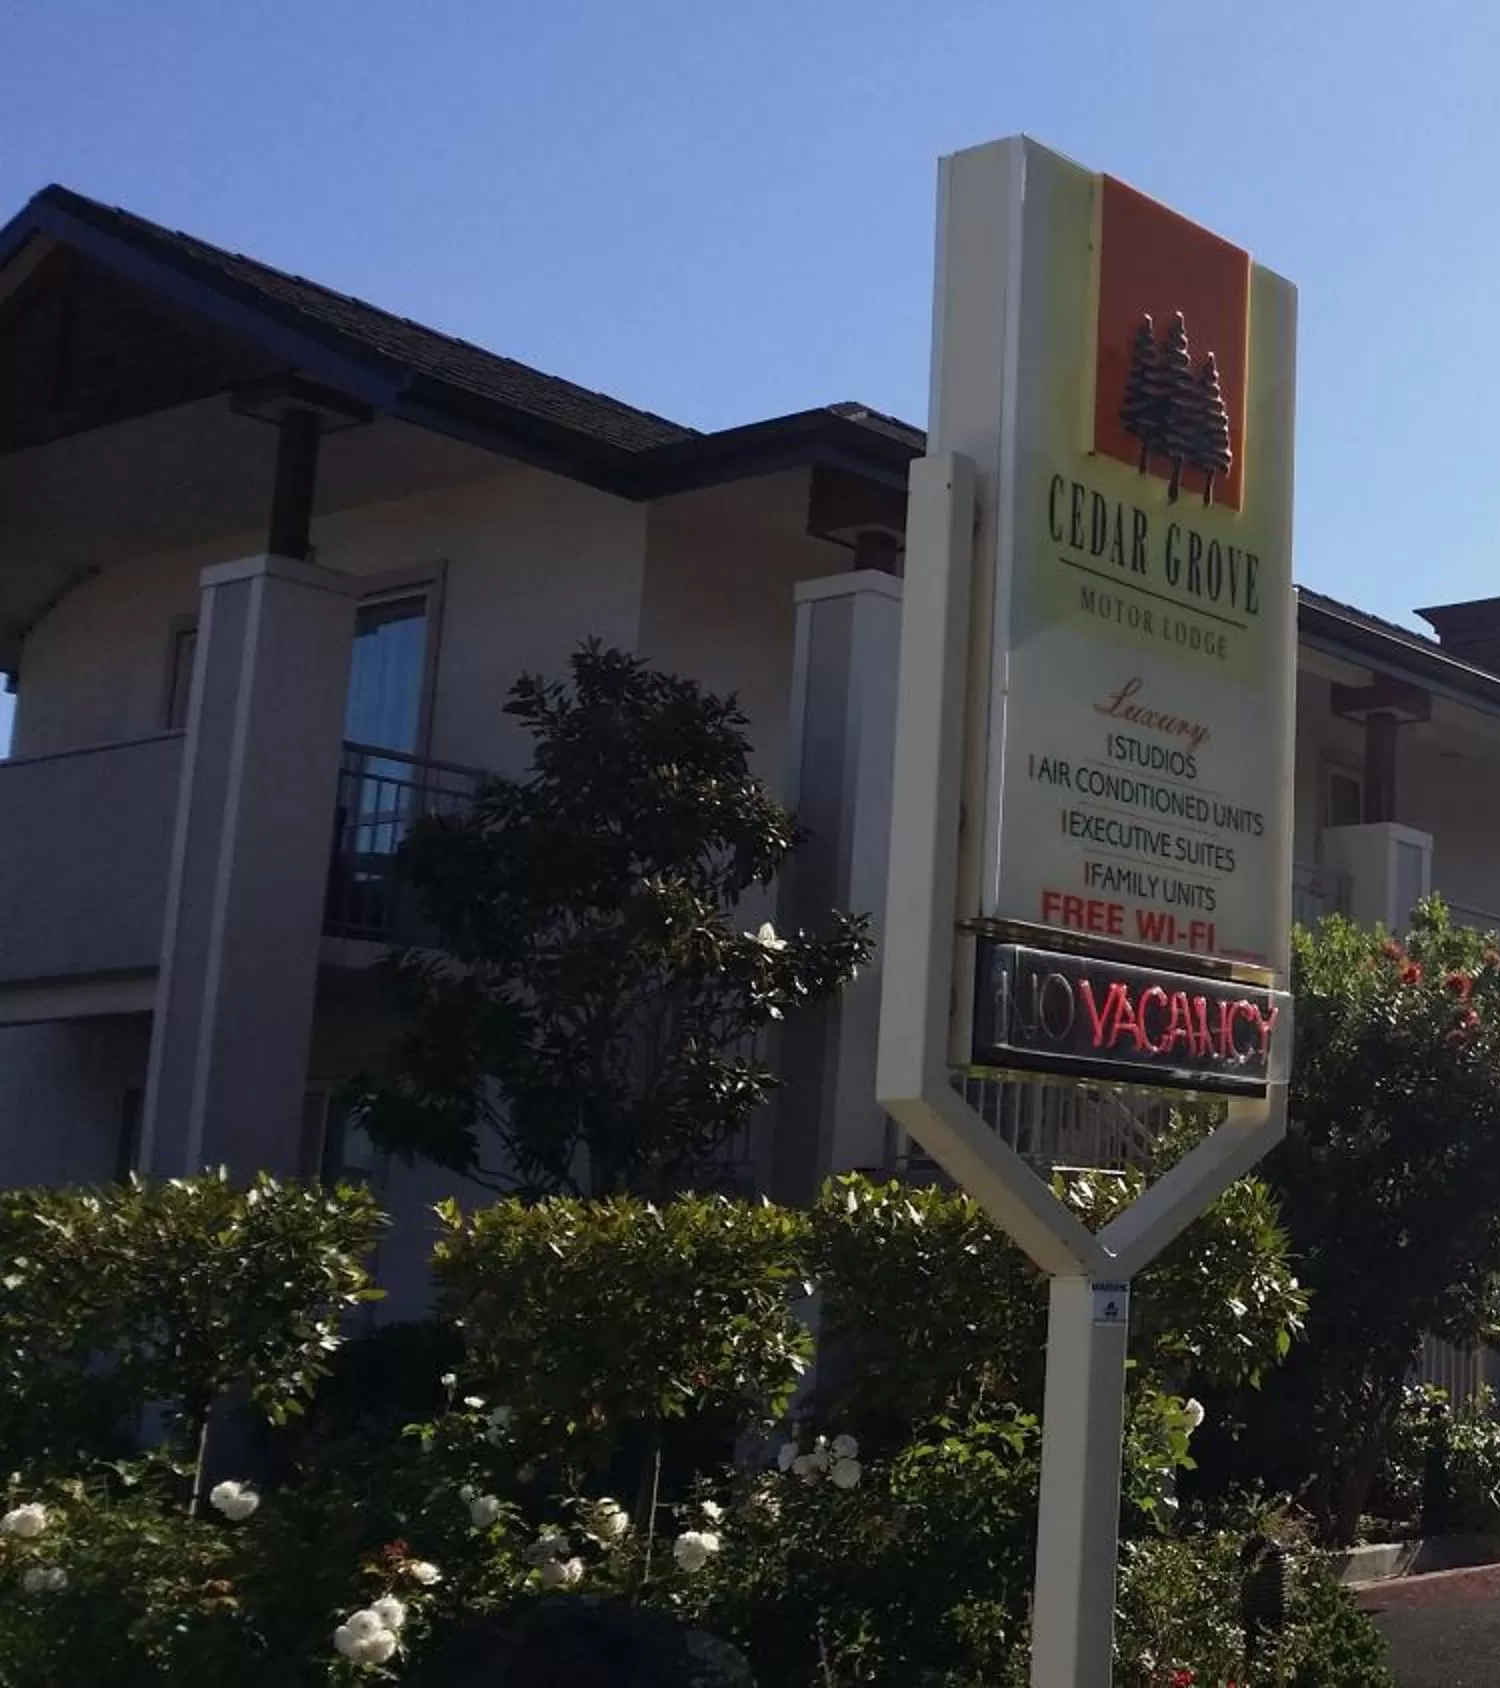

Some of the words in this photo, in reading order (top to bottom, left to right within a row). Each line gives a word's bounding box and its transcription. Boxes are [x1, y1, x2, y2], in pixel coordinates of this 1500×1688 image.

[1049, 473, 1148, 575] CEDAR
[1165, 522, 1259, 615] GROVE
[1080, 586, 1153, 635] MOTOR
[1163, 618, 1228, 660] LODGE
[1094, 676, 1210, 748] Luxury
[1115, 735, 1197, 779] STUDIOS
[1038, 757, 1071, 788] AIR
[1075, 767, 1209, 823] CONDITIONED
[1214, 804, 1264, 837] UNITS
[1069, 811, 1171, 858] EXECUTIVE
[1175, 837, 1235, 872] SUITES
[1041, 890, 1125, 935] FREE
[1136, 908, 1217, 951] WI-FI
[1090, 863, 1158, 898] FAMILY
[1162, 882, 1217, 911] UNITS
[997, 971, 1075, 1042] NO
[1077, 978, 1279, 1066] VACANCY
